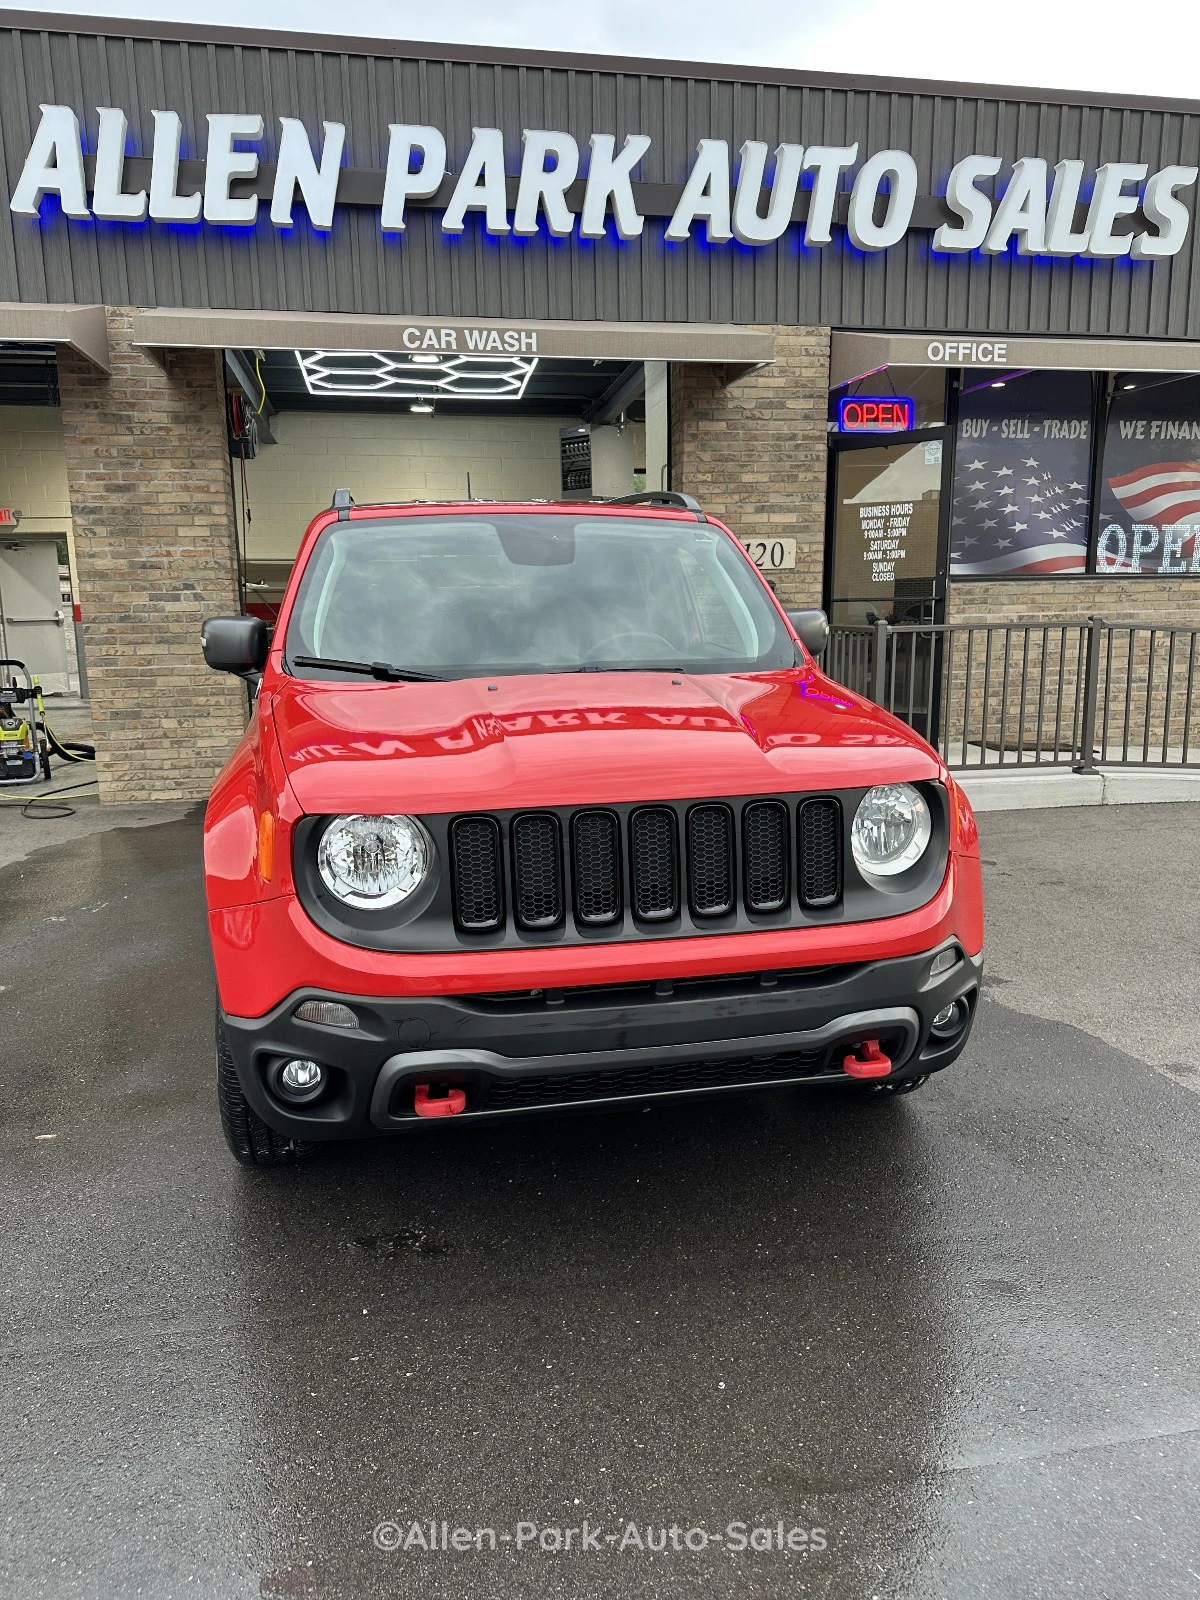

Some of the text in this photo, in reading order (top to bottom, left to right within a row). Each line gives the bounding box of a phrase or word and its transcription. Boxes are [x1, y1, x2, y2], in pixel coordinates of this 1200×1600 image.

[10, 103, 1198, 260] ALLEN PARK AUTO SALES
[402, 327, 538, 352] CAR WASH
[927, 341, 1007, 363] OFFICE
[843, 403, 909, 430] OPEN
[962, 418, 991, 438] BUY
[1001, 418, 1031, 439] SELL
[1043, 419, 1089, 439] TRADE
[1119, 420, 1147, 440] WE
[860, 503, 913, 517] BUSINESS HOURS
[861, 519, 885, 529] MONDAY
[890, 517, 910, 527] FRIDAY
[870, 539, 899, 550] SATURDAY
[872, 562, 895, 572] SUNDAY
[872, 572, 895, 581] CLOSED
